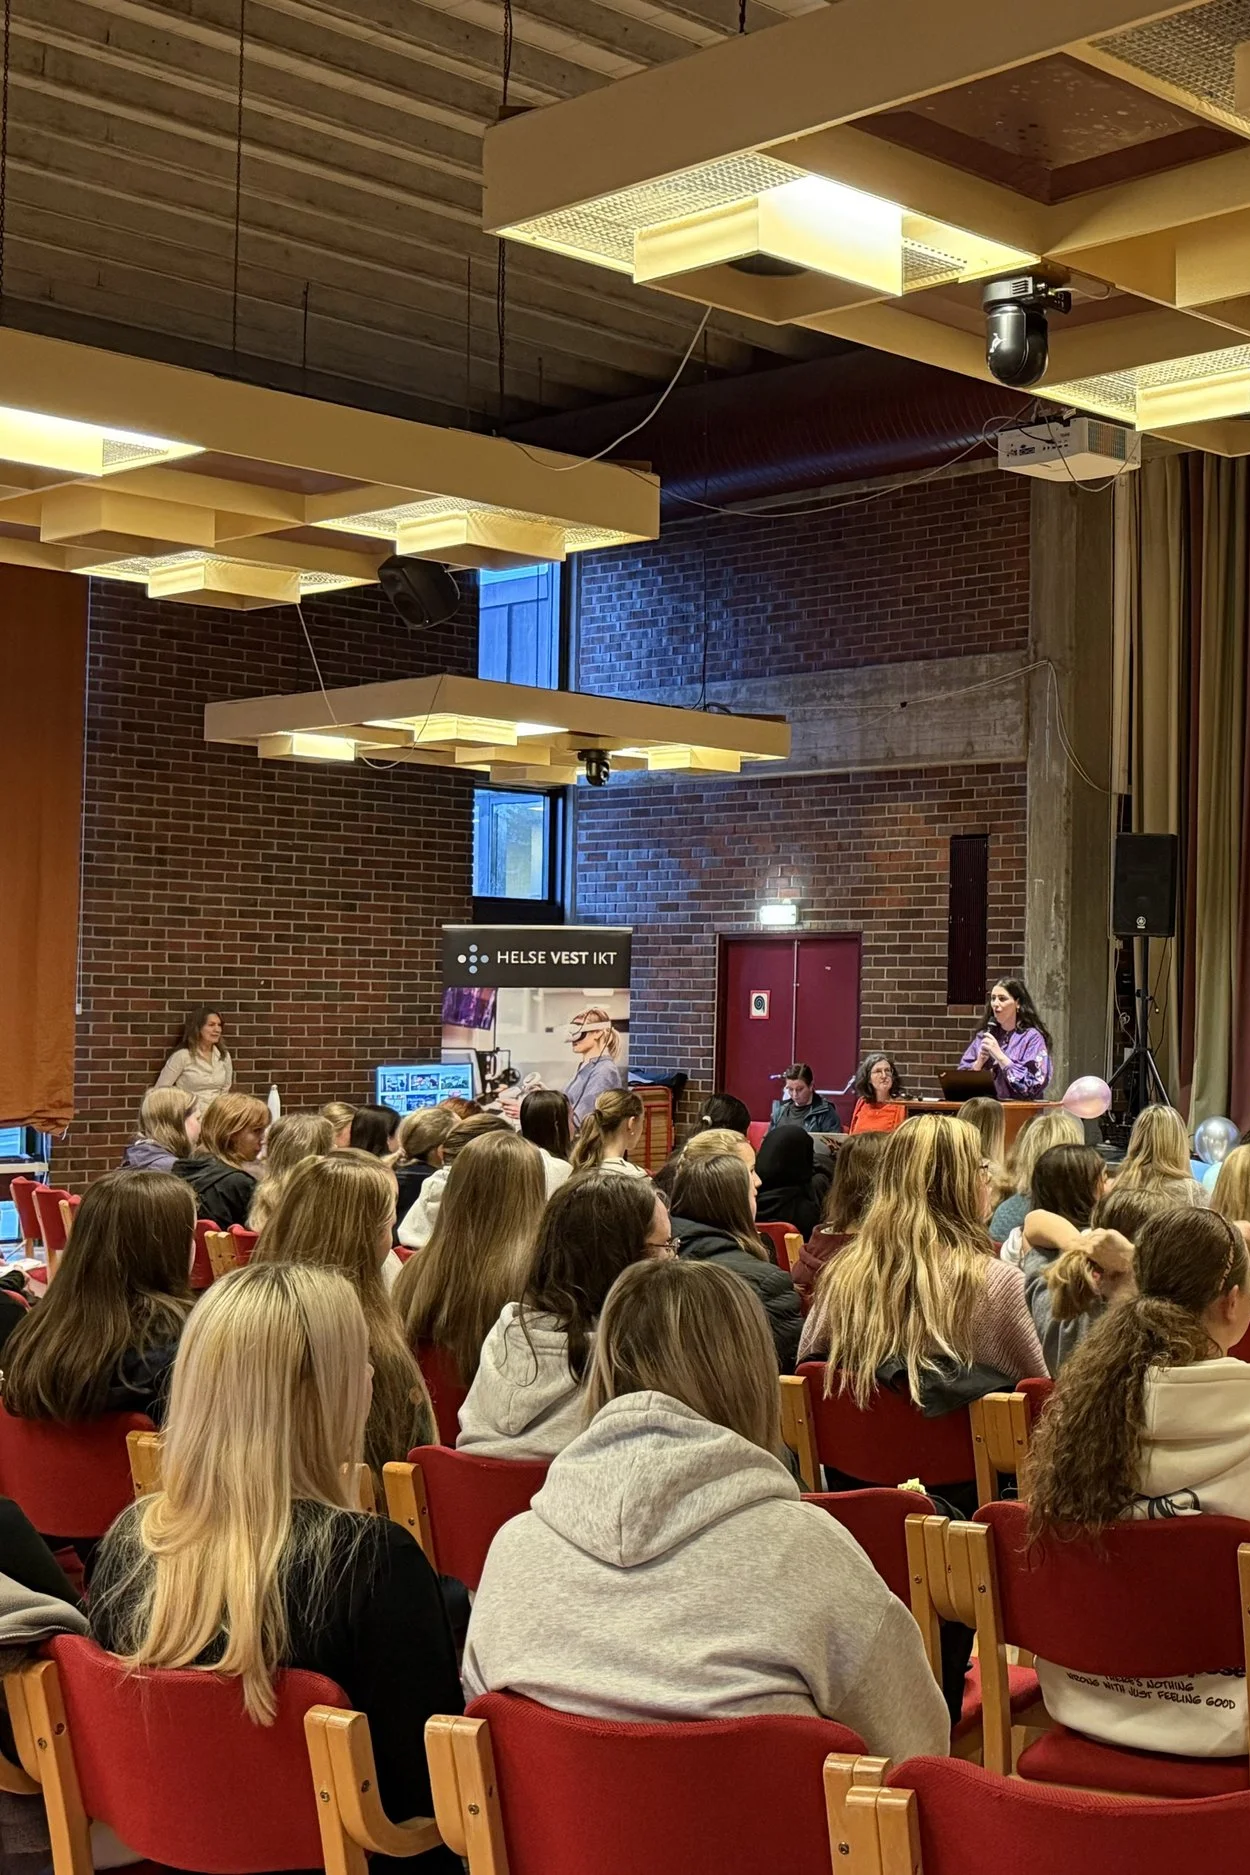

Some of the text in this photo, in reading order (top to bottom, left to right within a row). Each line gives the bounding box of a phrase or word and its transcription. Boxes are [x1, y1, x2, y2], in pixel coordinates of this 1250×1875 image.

[497, 950, 618, 965] HELSE VEST IKT
[1066, 1671, 1236, 1710] WRONG WITH JUST FEELING GOOD
[1146, 1679, 1194, 1692] NOTHING
